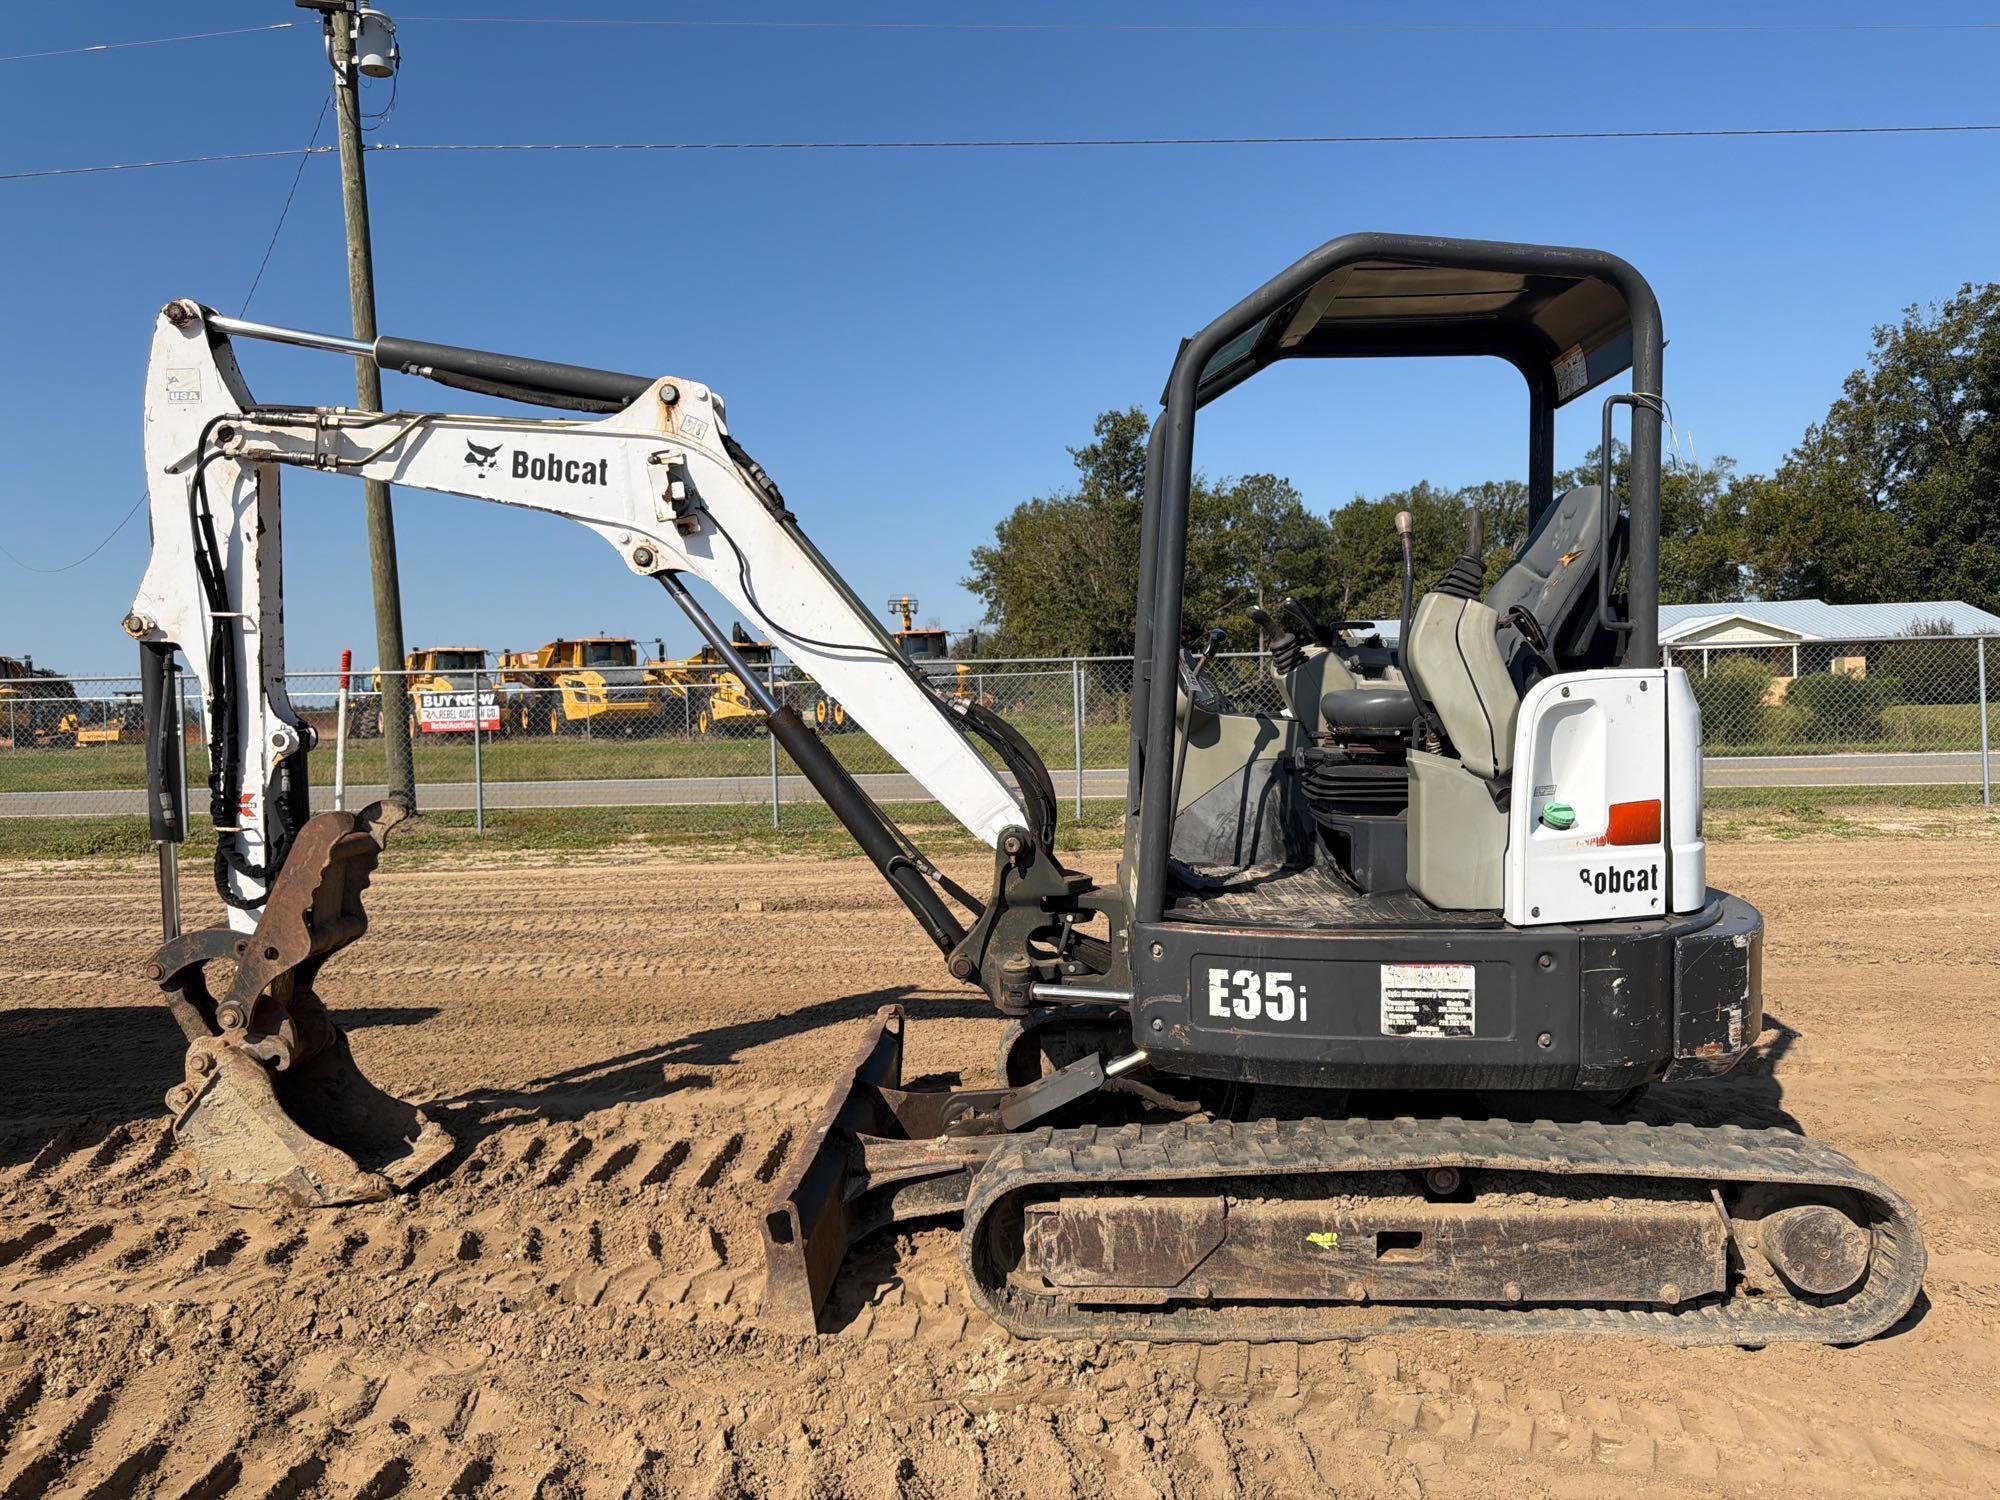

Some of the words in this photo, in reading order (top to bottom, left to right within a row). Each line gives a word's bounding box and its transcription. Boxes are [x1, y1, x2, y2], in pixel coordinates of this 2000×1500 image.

[169, 391, 200, 400] USA
[512, 450, 608, 486] Bobcat
[423, 695, 454, 707] BUY
[439, 709, 457, 719] REBEL
[459, 708, 485, 719] AUCTN
[1402, 990, 1437, 999] Machinery
[1437, 991, 1469, 999] Company
